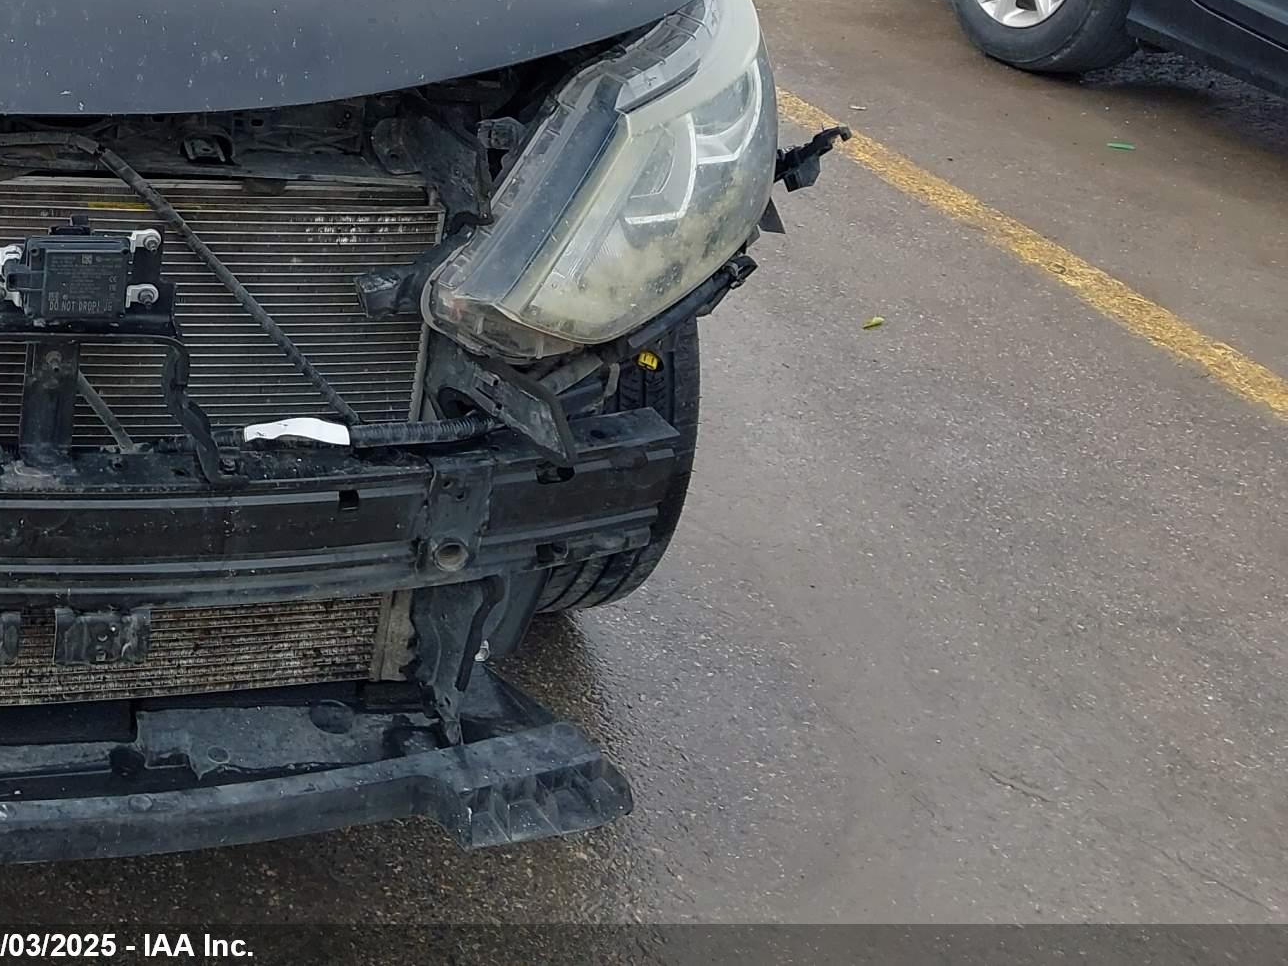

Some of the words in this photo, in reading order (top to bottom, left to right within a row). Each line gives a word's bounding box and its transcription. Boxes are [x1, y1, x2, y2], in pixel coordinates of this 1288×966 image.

[49, 300, 59, 311] DO
[61, 300, 76, 312] NOT
[78, 301, 100, 313] DROP!
